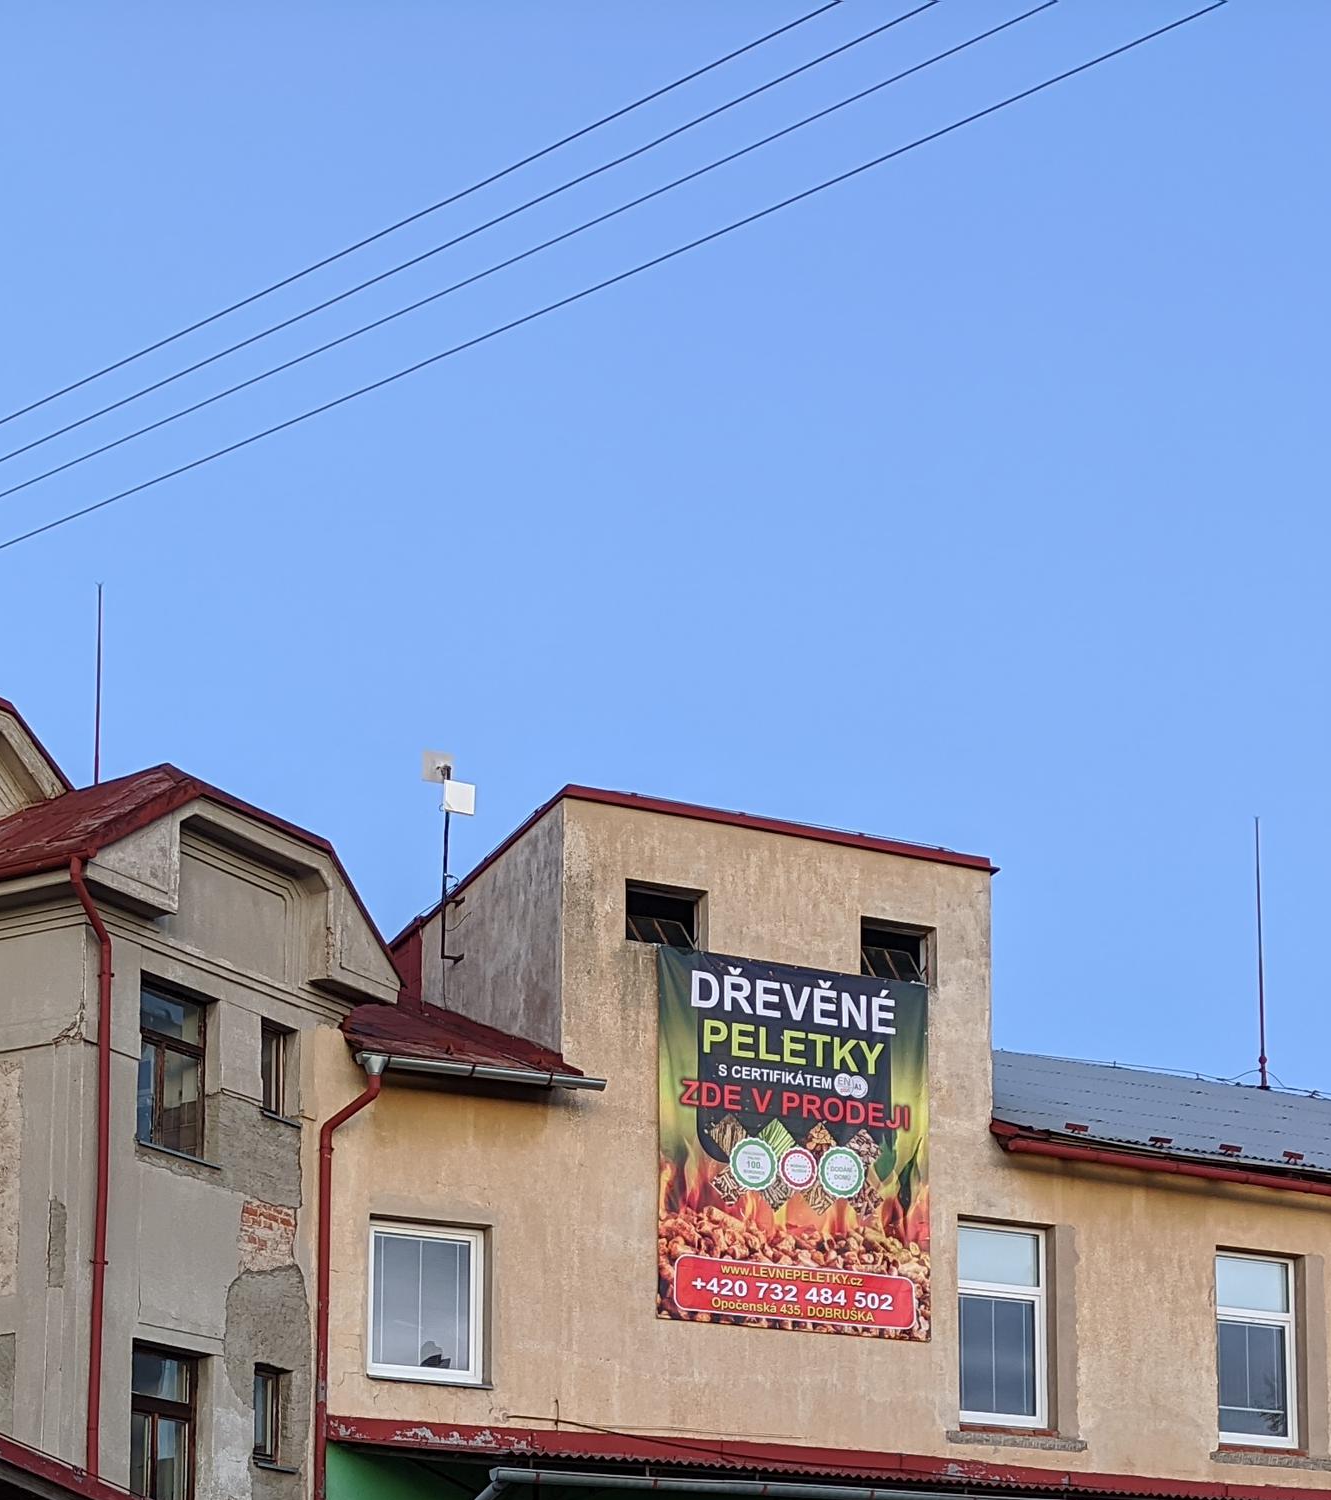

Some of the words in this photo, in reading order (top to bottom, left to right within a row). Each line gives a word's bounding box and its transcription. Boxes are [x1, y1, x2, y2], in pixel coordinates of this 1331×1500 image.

[690, 966, 897, 1035] DŘEVĚNÉ
[703, 1018, 885, 1075] PELETKY
[718, 1064, 728, 1078] S
[731, 1065, 832, 1091] CERTIFIKÁTEM
[679, 1078, 743, 1112] ZDE
[751, 1087, 774, 1114] V
[721, 1263, 864, 1287] www.LEVNEPELETKY.cz
[691, 1277, 748, 1298] +420
[755, 1281, 798, 1302] 732
[804, 1287, 847, 1307] 484
[853, 1291, 894, 1311] 502
[711, 1296, 778, 1315] Opočenská
[806, 1304, 876, 1323] DOBRUŠKA
